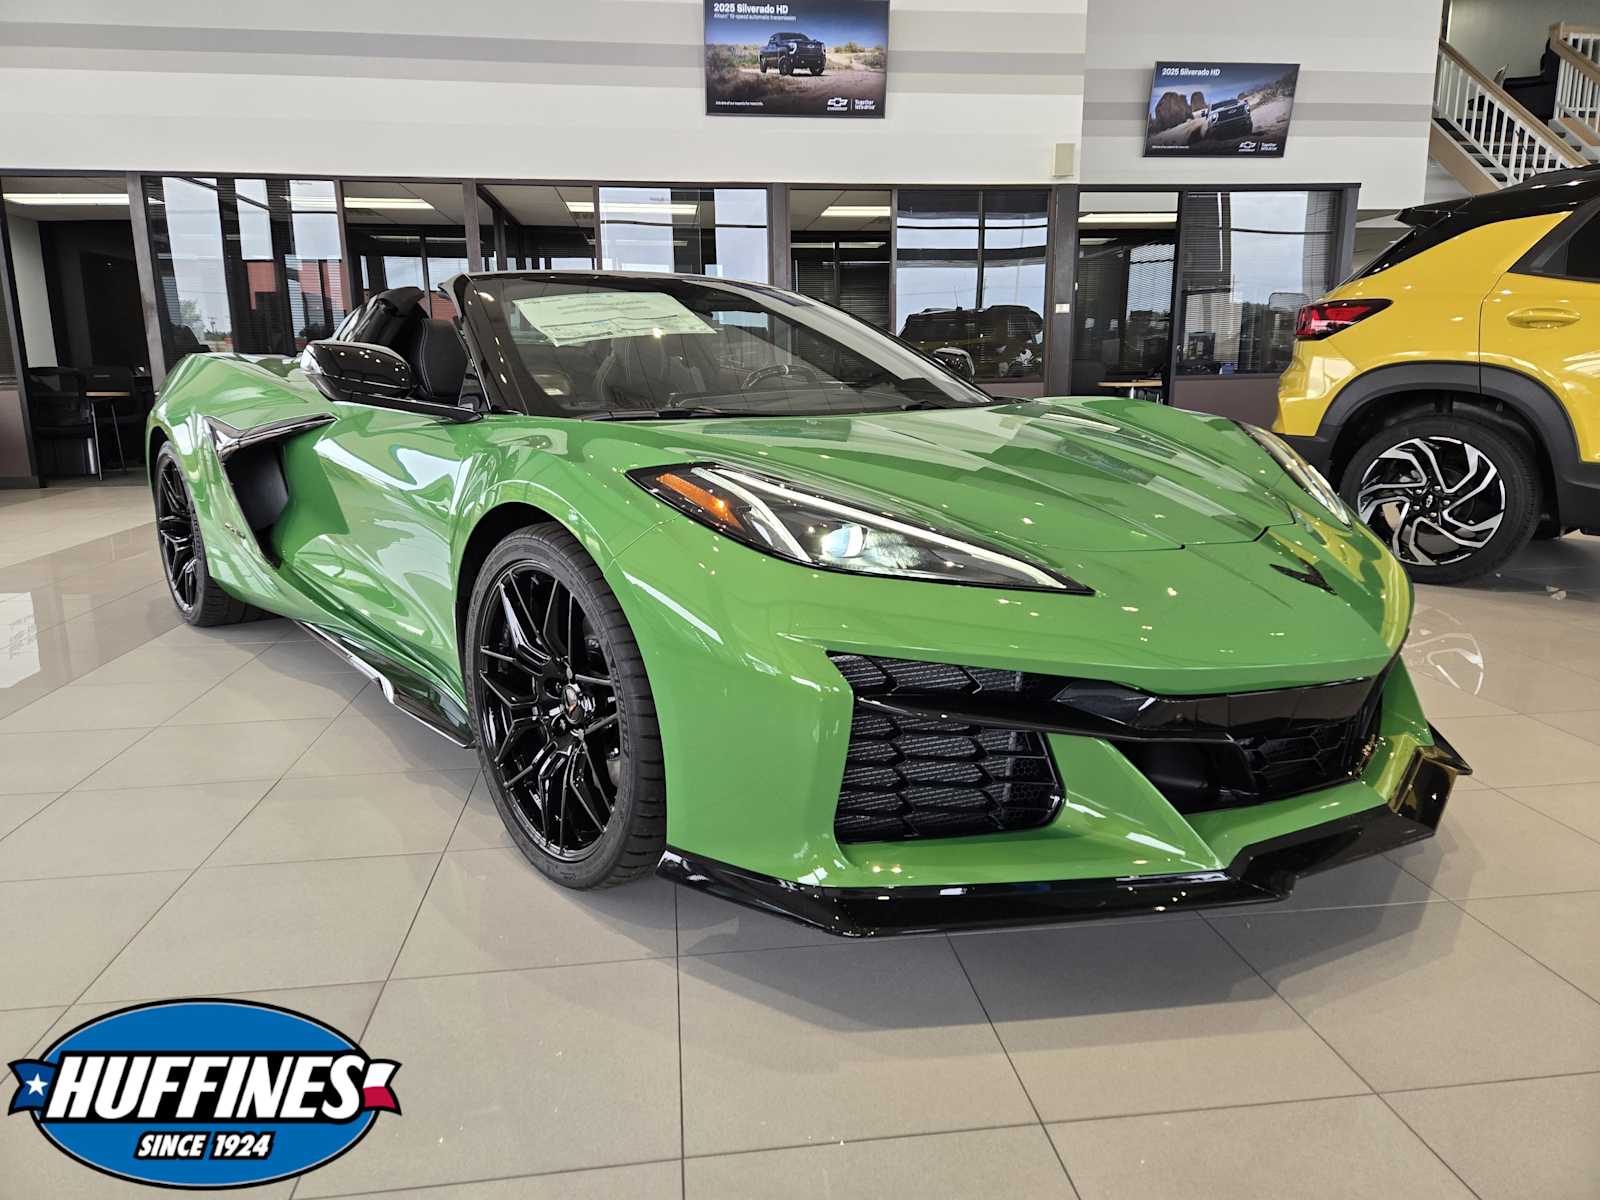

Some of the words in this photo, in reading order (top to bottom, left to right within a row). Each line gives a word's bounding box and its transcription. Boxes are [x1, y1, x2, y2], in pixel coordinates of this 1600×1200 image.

[714, 3, 735, 13] 2025
[736, 3, 775, 14] Silverado
[776, 5, 788, 14] HD
[1162, 67, 1179, 76] 2025
[1180, 67, 1210, 76] Silverado
[1210, 68, 1220, 76] HD
